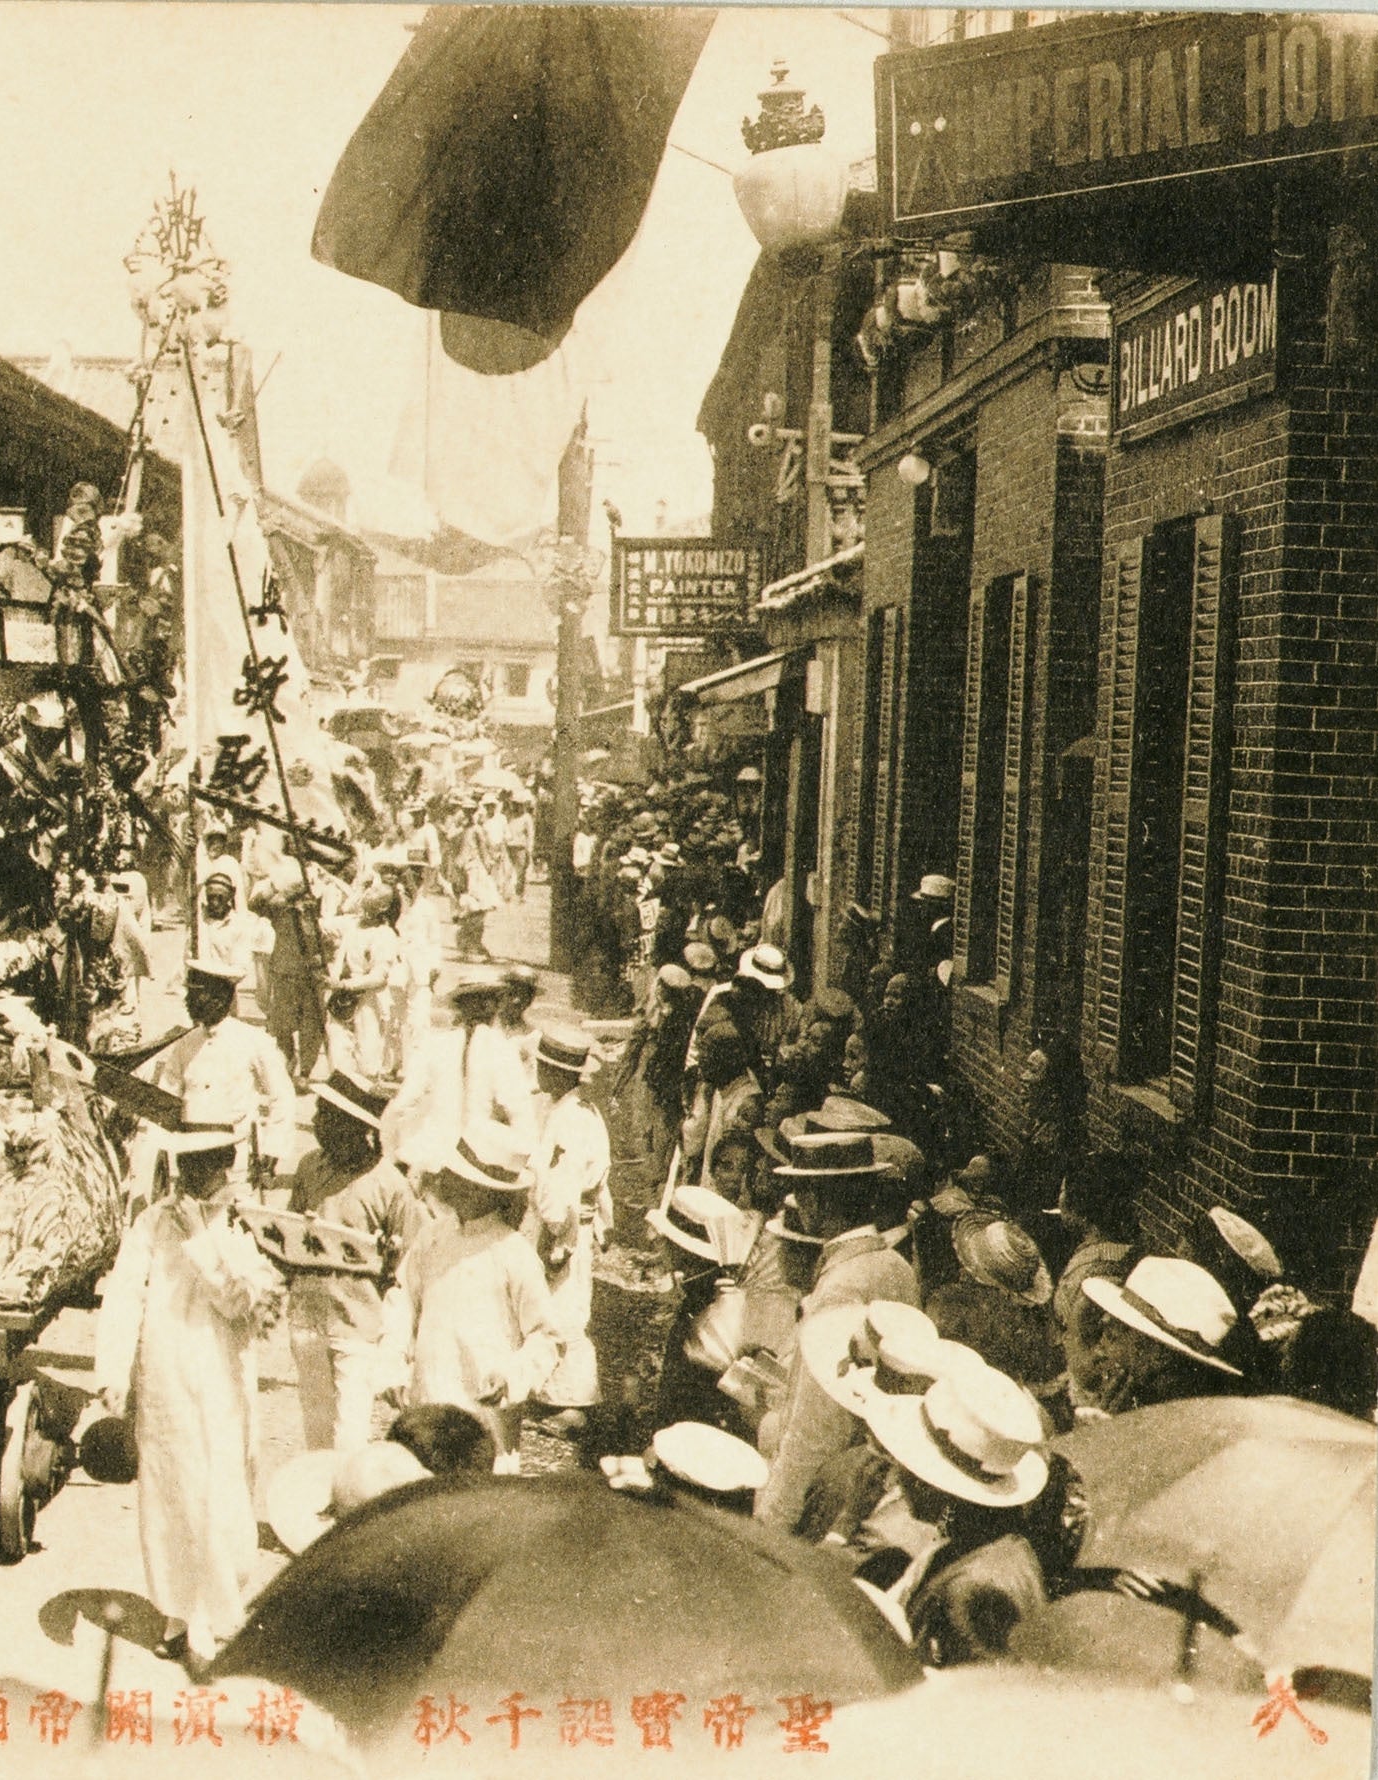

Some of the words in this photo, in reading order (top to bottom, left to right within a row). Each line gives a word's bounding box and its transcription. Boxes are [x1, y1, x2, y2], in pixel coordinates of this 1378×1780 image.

[954, 43, 1221, 185] IMPERIAL
[1210, 268, 1278, 375] ROOM
[649, 578, 736, 596] PAINTER
